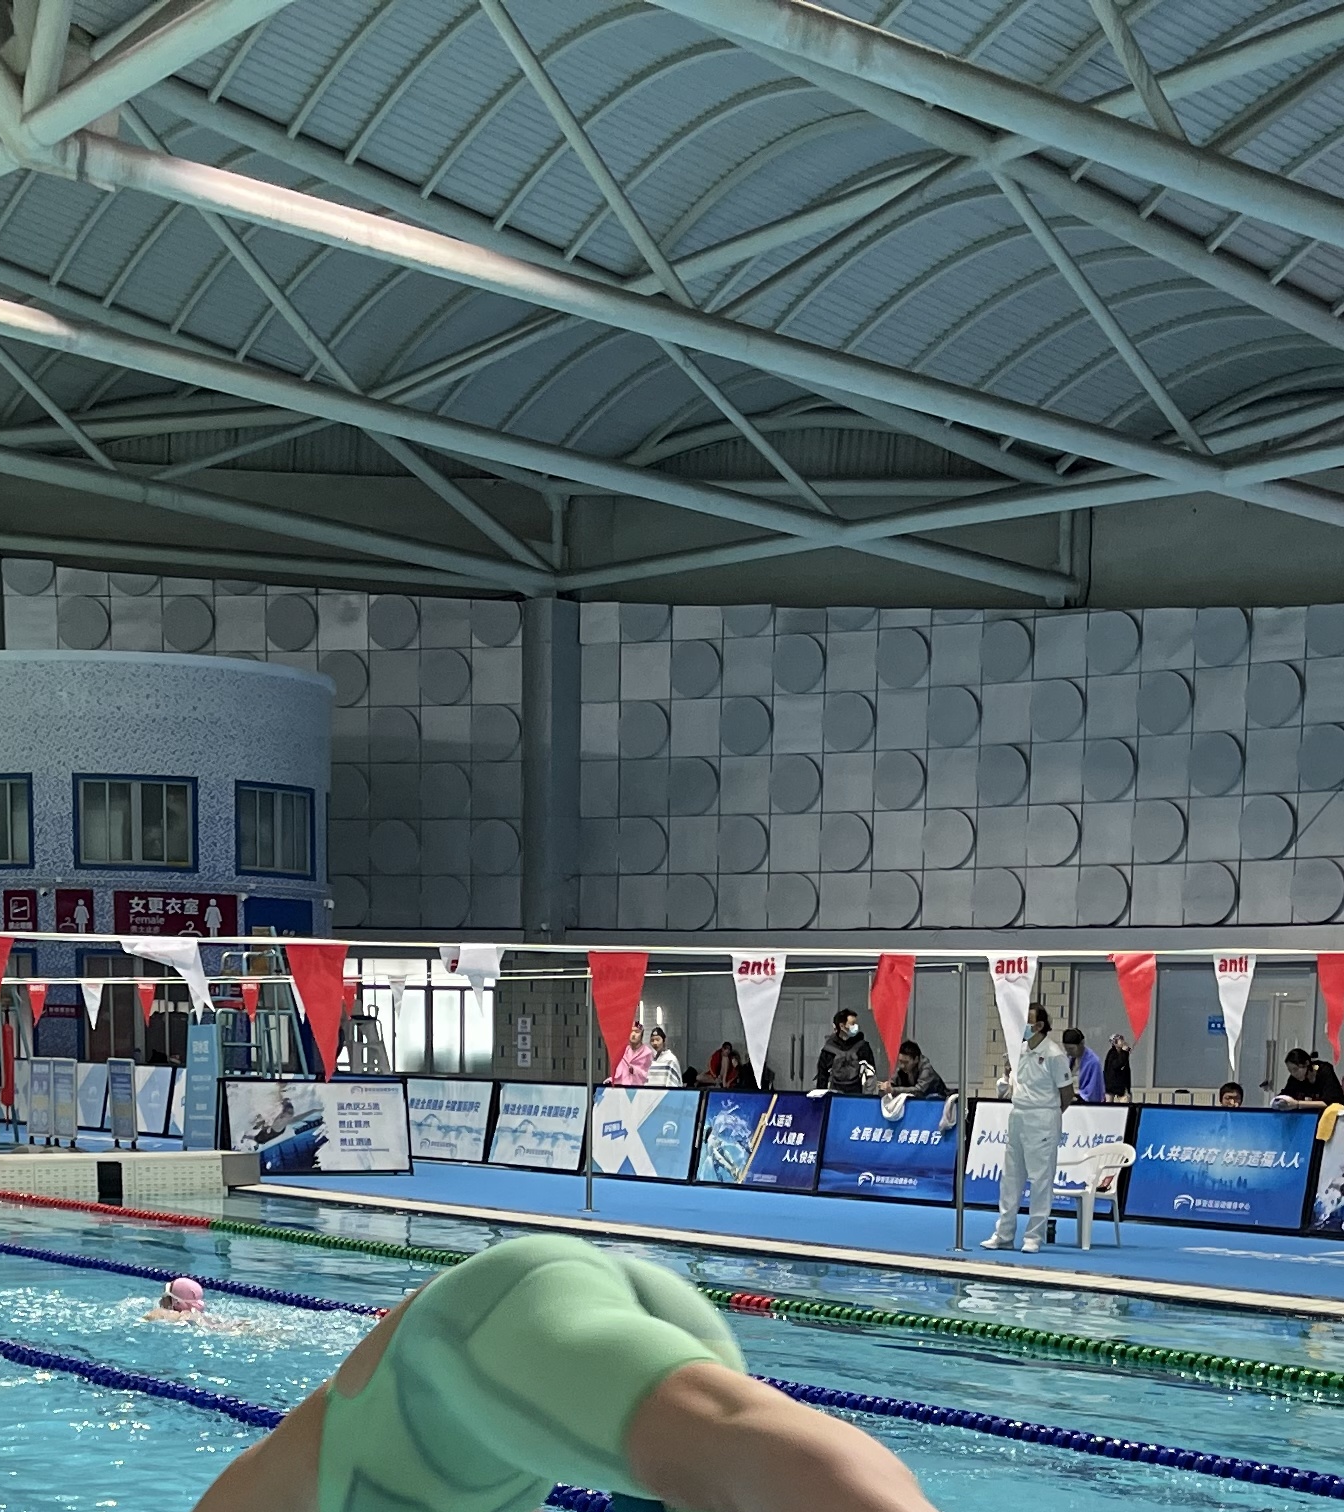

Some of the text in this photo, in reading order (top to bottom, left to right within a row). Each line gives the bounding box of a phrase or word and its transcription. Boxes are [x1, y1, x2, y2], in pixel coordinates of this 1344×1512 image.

[129, 896, 199, 915] 女更衣室
[130, 914, 165, 925] Female
[737, 957, 776, 976] anti
[995, 956, 1028, 975] anti
[1218, 955, 1248, 974] anti
[849, 1126, 894, 1143] 全民健身
[782, 1149, 817, 1164] 人人快乐
[1141, 1143, 1301, 1169] 人人共享体育 体育造福人人
